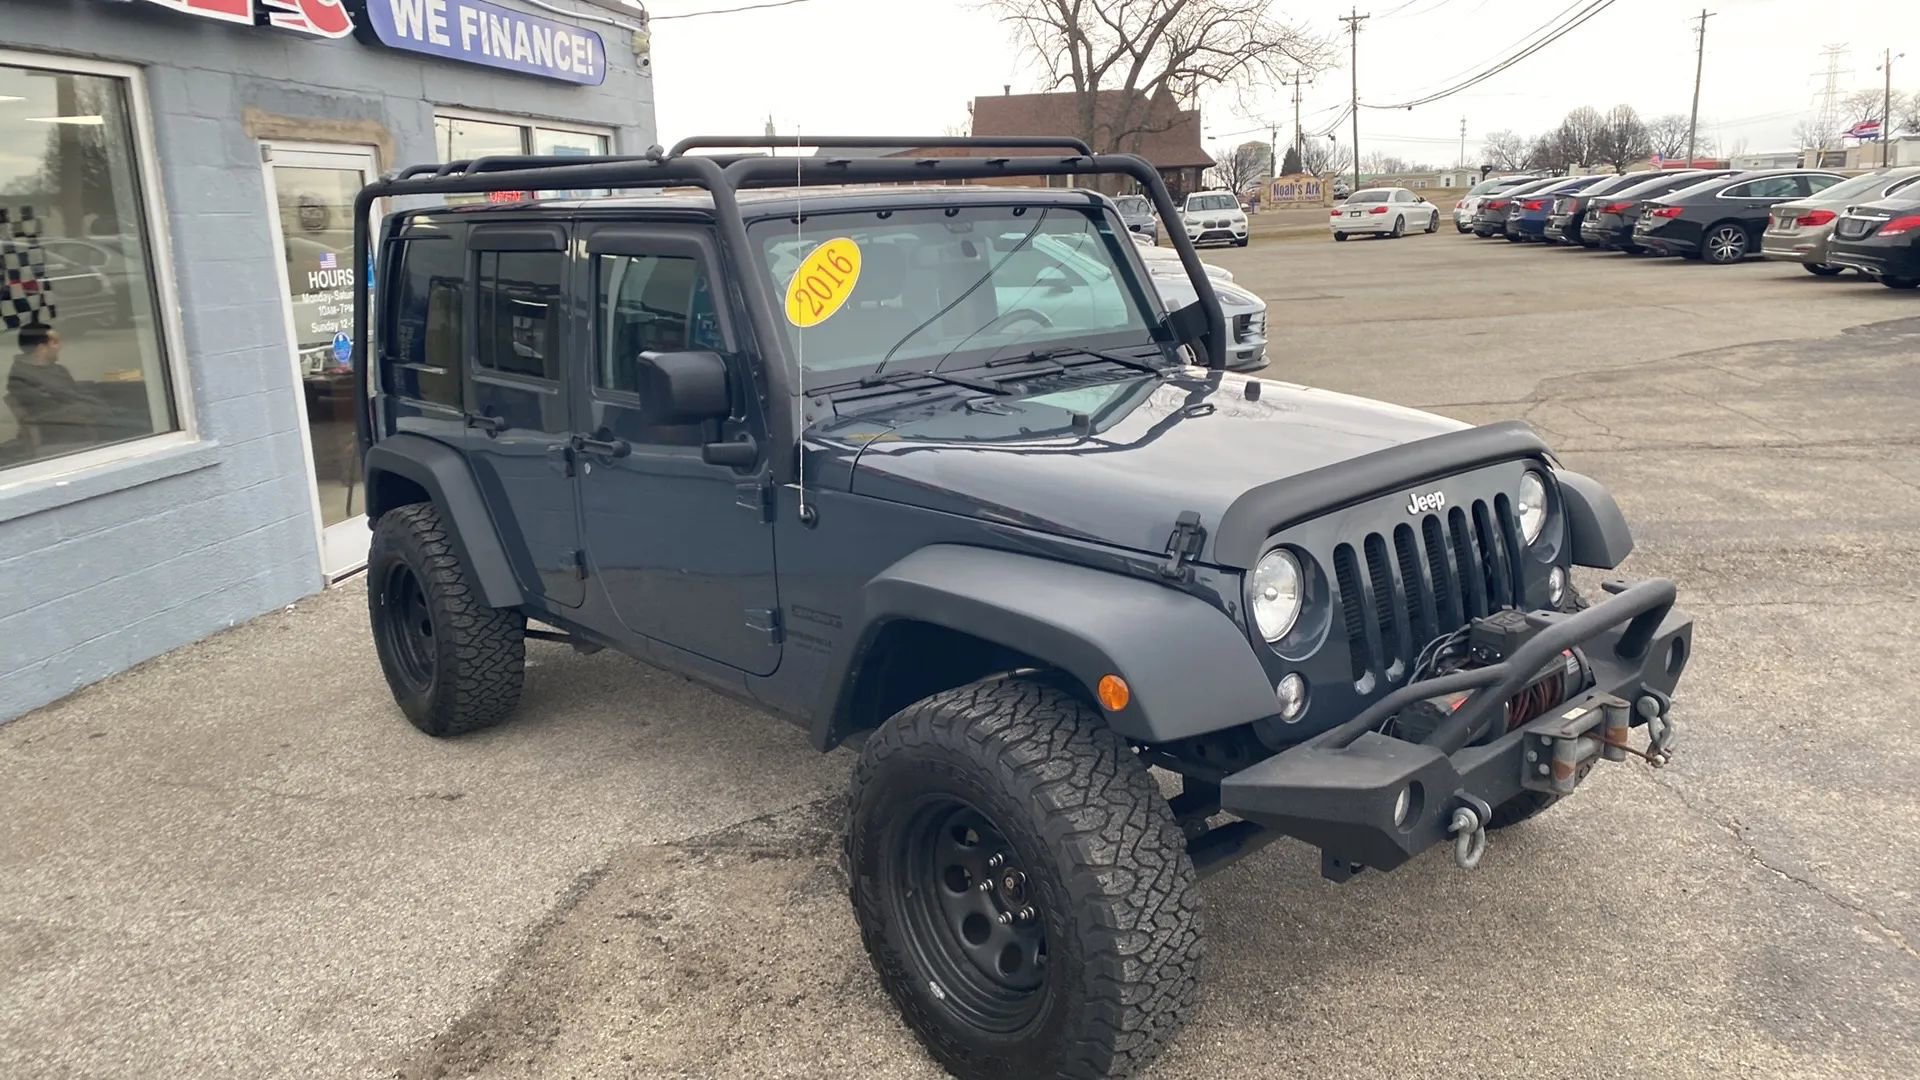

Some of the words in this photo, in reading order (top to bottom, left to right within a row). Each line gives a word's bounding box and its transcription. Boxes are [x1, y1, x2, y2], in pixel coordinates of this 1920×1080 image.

[390, 0, 450, 47] WE
[459, 5, 593, 76] FINANCE!
[1273, 183, 1303, 196] Noah's
[1305, 181, 1321, 195] Ark
[308, 268, 354, 289] HOURS
[795, 248, 853, 317] 2016
[311, 321, 339, 333] Sunday
[1407, 491, 1445, 515] Jeep
